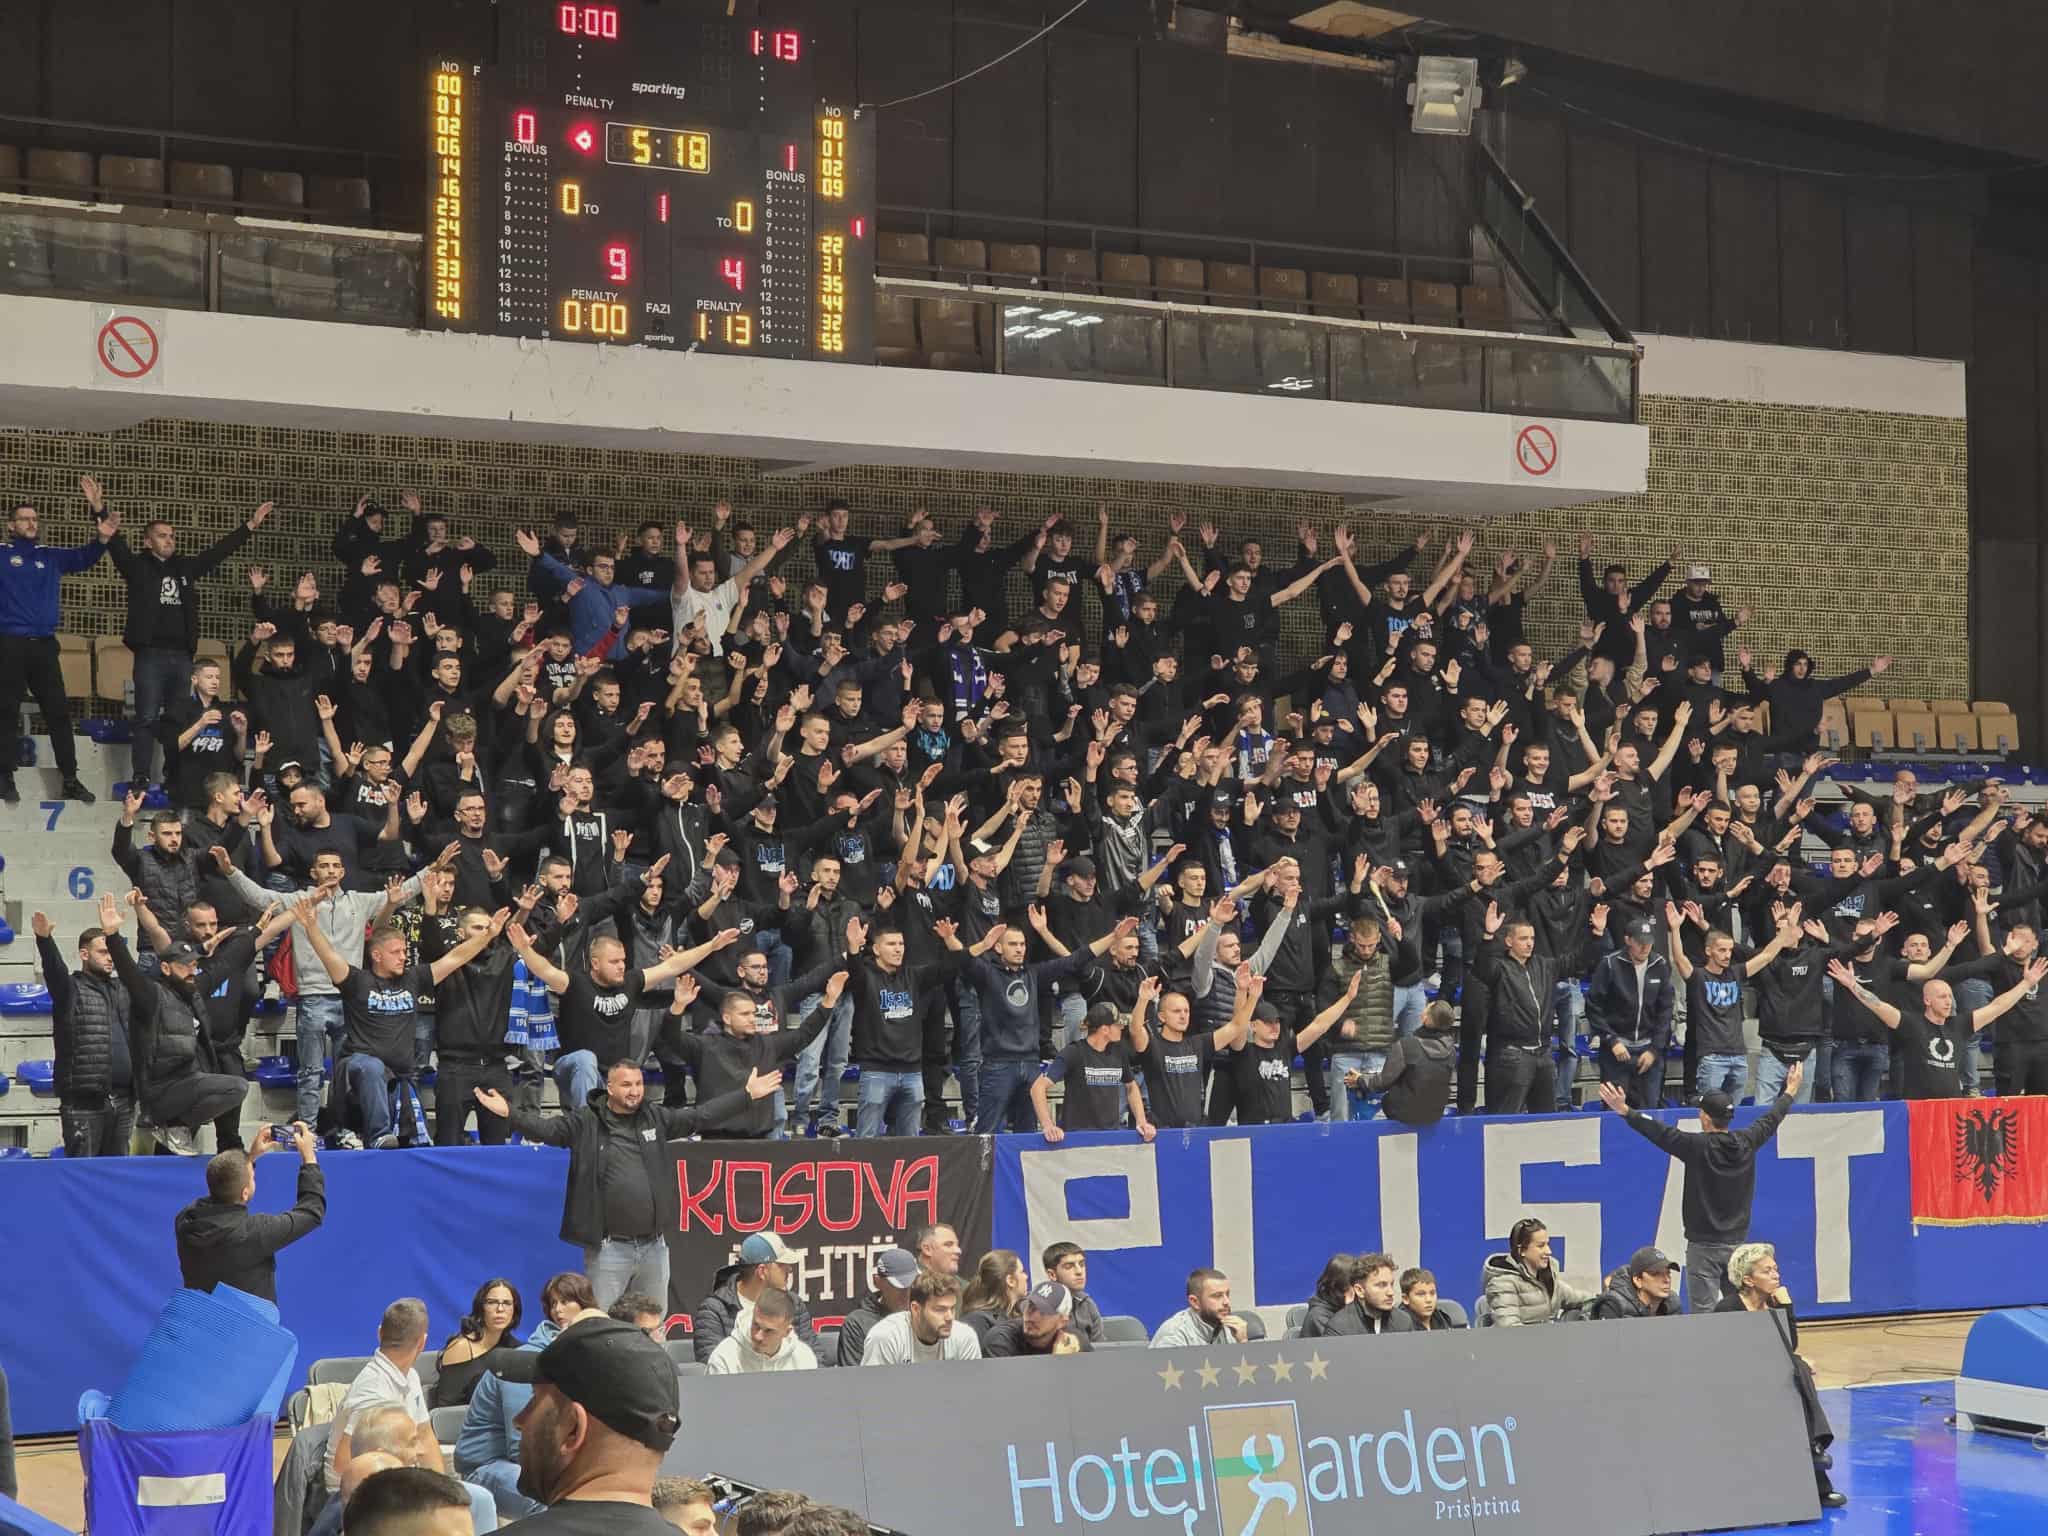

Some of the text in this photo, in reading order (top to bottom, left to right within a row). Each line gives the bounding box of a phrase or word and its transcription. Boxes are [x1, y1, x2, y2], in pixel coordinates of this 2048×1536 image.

[561, 6, 617, 38] 0:00
[753, 30, 798, 61] 1:13
[441, 61, 459, 73] NO
[473, 65, 480, 76] F
[437, 75, 461, 95] 00
[631, 82, 686, 99] sporting
[437, 95, 461, 115] 01
[565, 94, 614, 110] PENALTY
[824, 106, 841, 117] NO
[853, 109, 861, 120] F
[437, 116, 461, 136] 02
[518, 113, 535, 143] 0
[821, 119, 844, 139] 00
[437, 136, 461, 157] 06
[504, 141, 547, 155] BONUS
[632, 128, 707, 169] 5:18
[821, 140, 843, 157] 01
[504, 152, 511, 163] 4
[789, 145, 794, 171] 1
[442, 157, 460, 176] 14
[821, 158, 843, 177] 02
[766, 169, 806, 184] BONUS
[442, 178, 460, 197] 16
[504, 181, 511, 192] 6
[765, 181, 772, 190] 4
[821, 178, 843, 198] 09
[436, 197, 460, 217] 23
[504, 195, 511, 206] 7
[562, 184, 580, 215] 0
[765, 195, 772, 204] 5
[504, 210, 511, 220] 8
[583, 203, 600, 215] TO
[661, 194, 668, 223] 1
[735, 201, 752, 232] 0
[765, 208, 772, 218] 6
[436, 218, 460, 236] 24
[504, 225, 511, 235] 9
[716, 216, 732, 228] TO
[765, 222, 772, 232] 7
[856, 219, 863, 239] 1
[436, 238, 460, 256] 27
[498, 239, 511, 249] 10
[765, 236, 772, 246] 8
[821, 235, 844, 255] 22
[498, 254, 511, 264] 11
[765, 250, 772, 260] 9
[822, 255, 843, 272] 31
[436, 258, 460, 278] 33
[498, 268, 511, 278] 12
[608, 248, 627, 281] 9
[760, 264, 772, 274] 10
[724, 259, 743, 290] 4
[760, 278, 772, 288] 11
[436, 280, 460, 298] 34
[498, 282, 511, 293] 13
[821, 275, 844, 294] 35
[498, 297, 511, 307] 14
[571, 288, 619, 304] PENALTY
[760, 292, 772, 302] 12
[821, 295, 844, 312] 44
[435, 301, 460, 318] 44
[645, 302, 671, 315] FAZI
[696, 300, 742, 313] PENALTY
[760, 306, 772, 316] 13
[498, 312, 511, 322] 15
[563, 300, 628, 335] 0:00
[760, 320, 772, 330] 14
[822, 313, 843, 331] 32
[700, 312, 751, 345] 1:13
[644, 333, 675, 344] sporting
[760, 334, 772, 344] 15
[821, 333, 844, 351] 55
[39, 802, 65, 831] 7
[68, 866, 95, 900] 6
[677, 1155, 939, 1235] KOSOVA
[1007, 1424, 1206, 1527] Hotel
[1435, 1496, 1521, 1520] Prishtina
